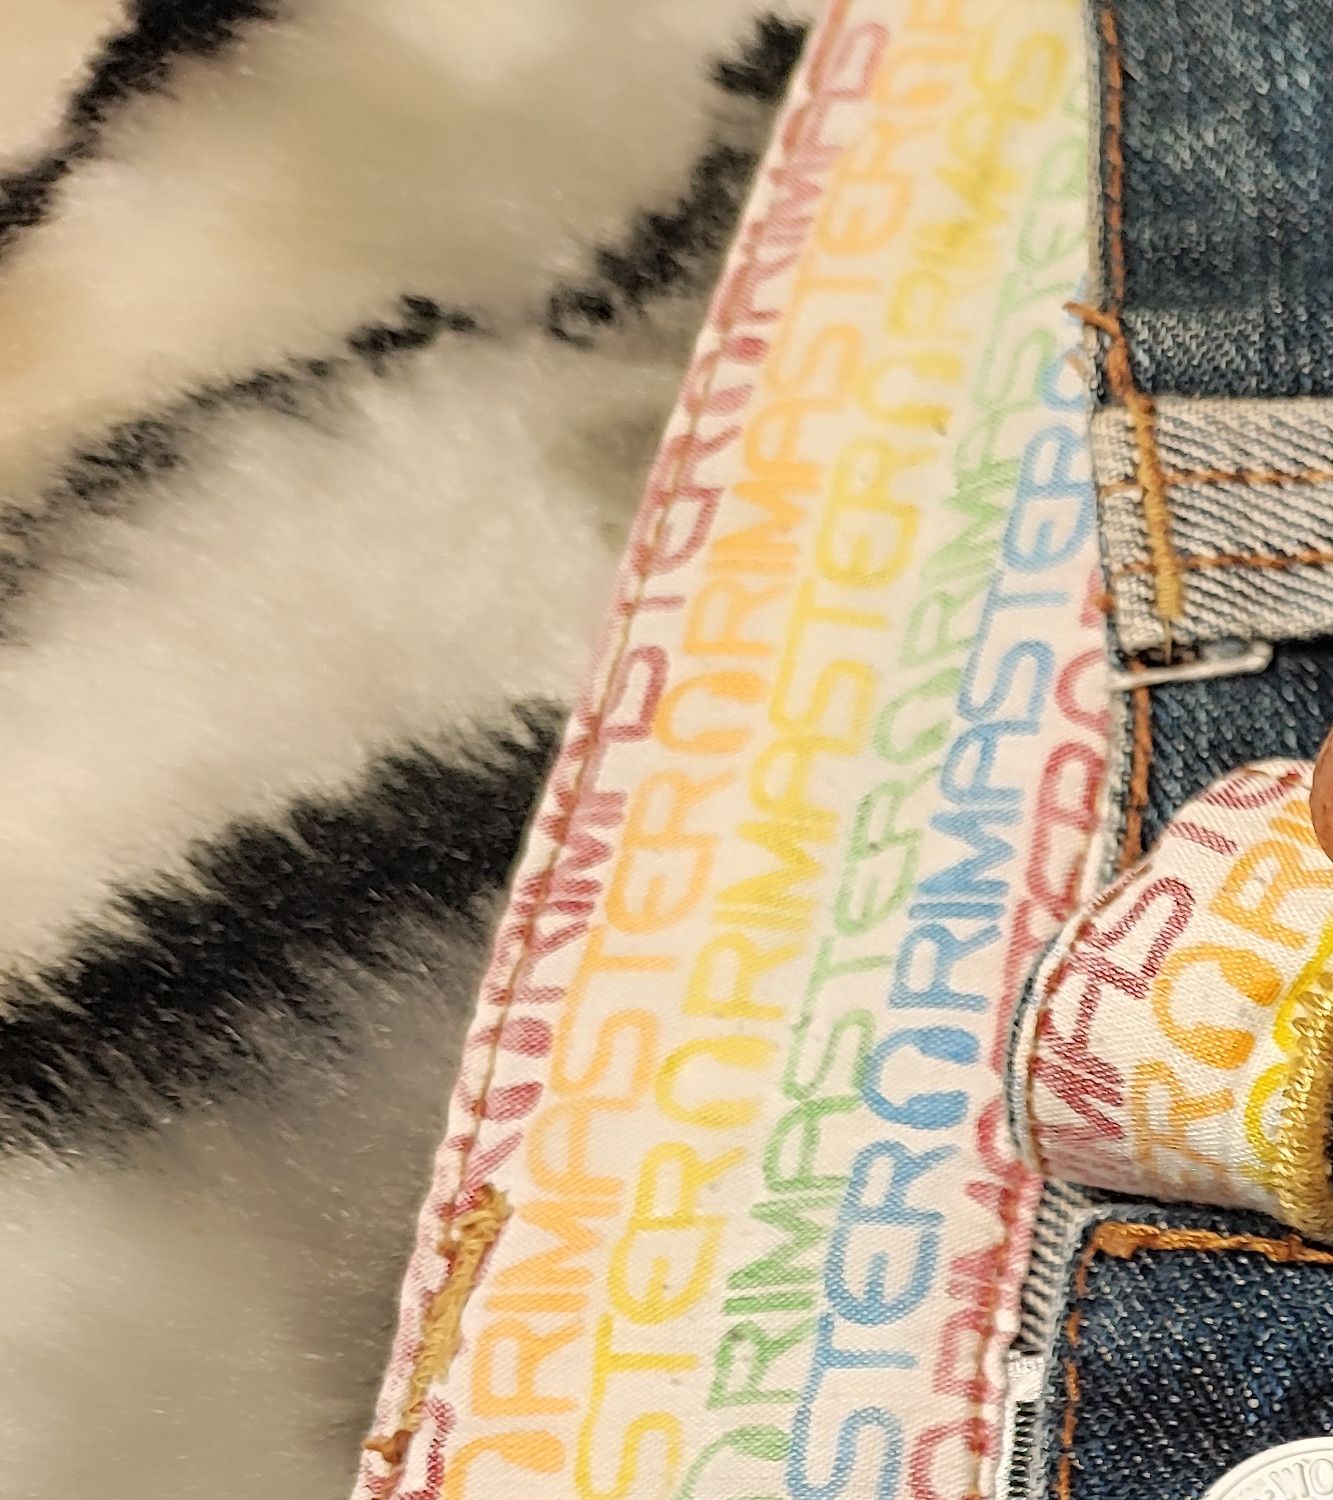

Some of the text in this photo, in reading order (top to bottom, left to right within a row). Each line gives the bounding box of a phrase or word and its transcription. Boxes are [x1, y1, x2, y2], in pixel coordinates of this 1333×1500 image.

[470, 768, 737, 1418] RIMASTER
[681, 115, 939, 657] RIMASTER
[681, 436, 936, 1021] RIMASTER
[887, 424, 1096, 1012] RIMASTER
[703, 763, 941, 1409] RIMASTER
